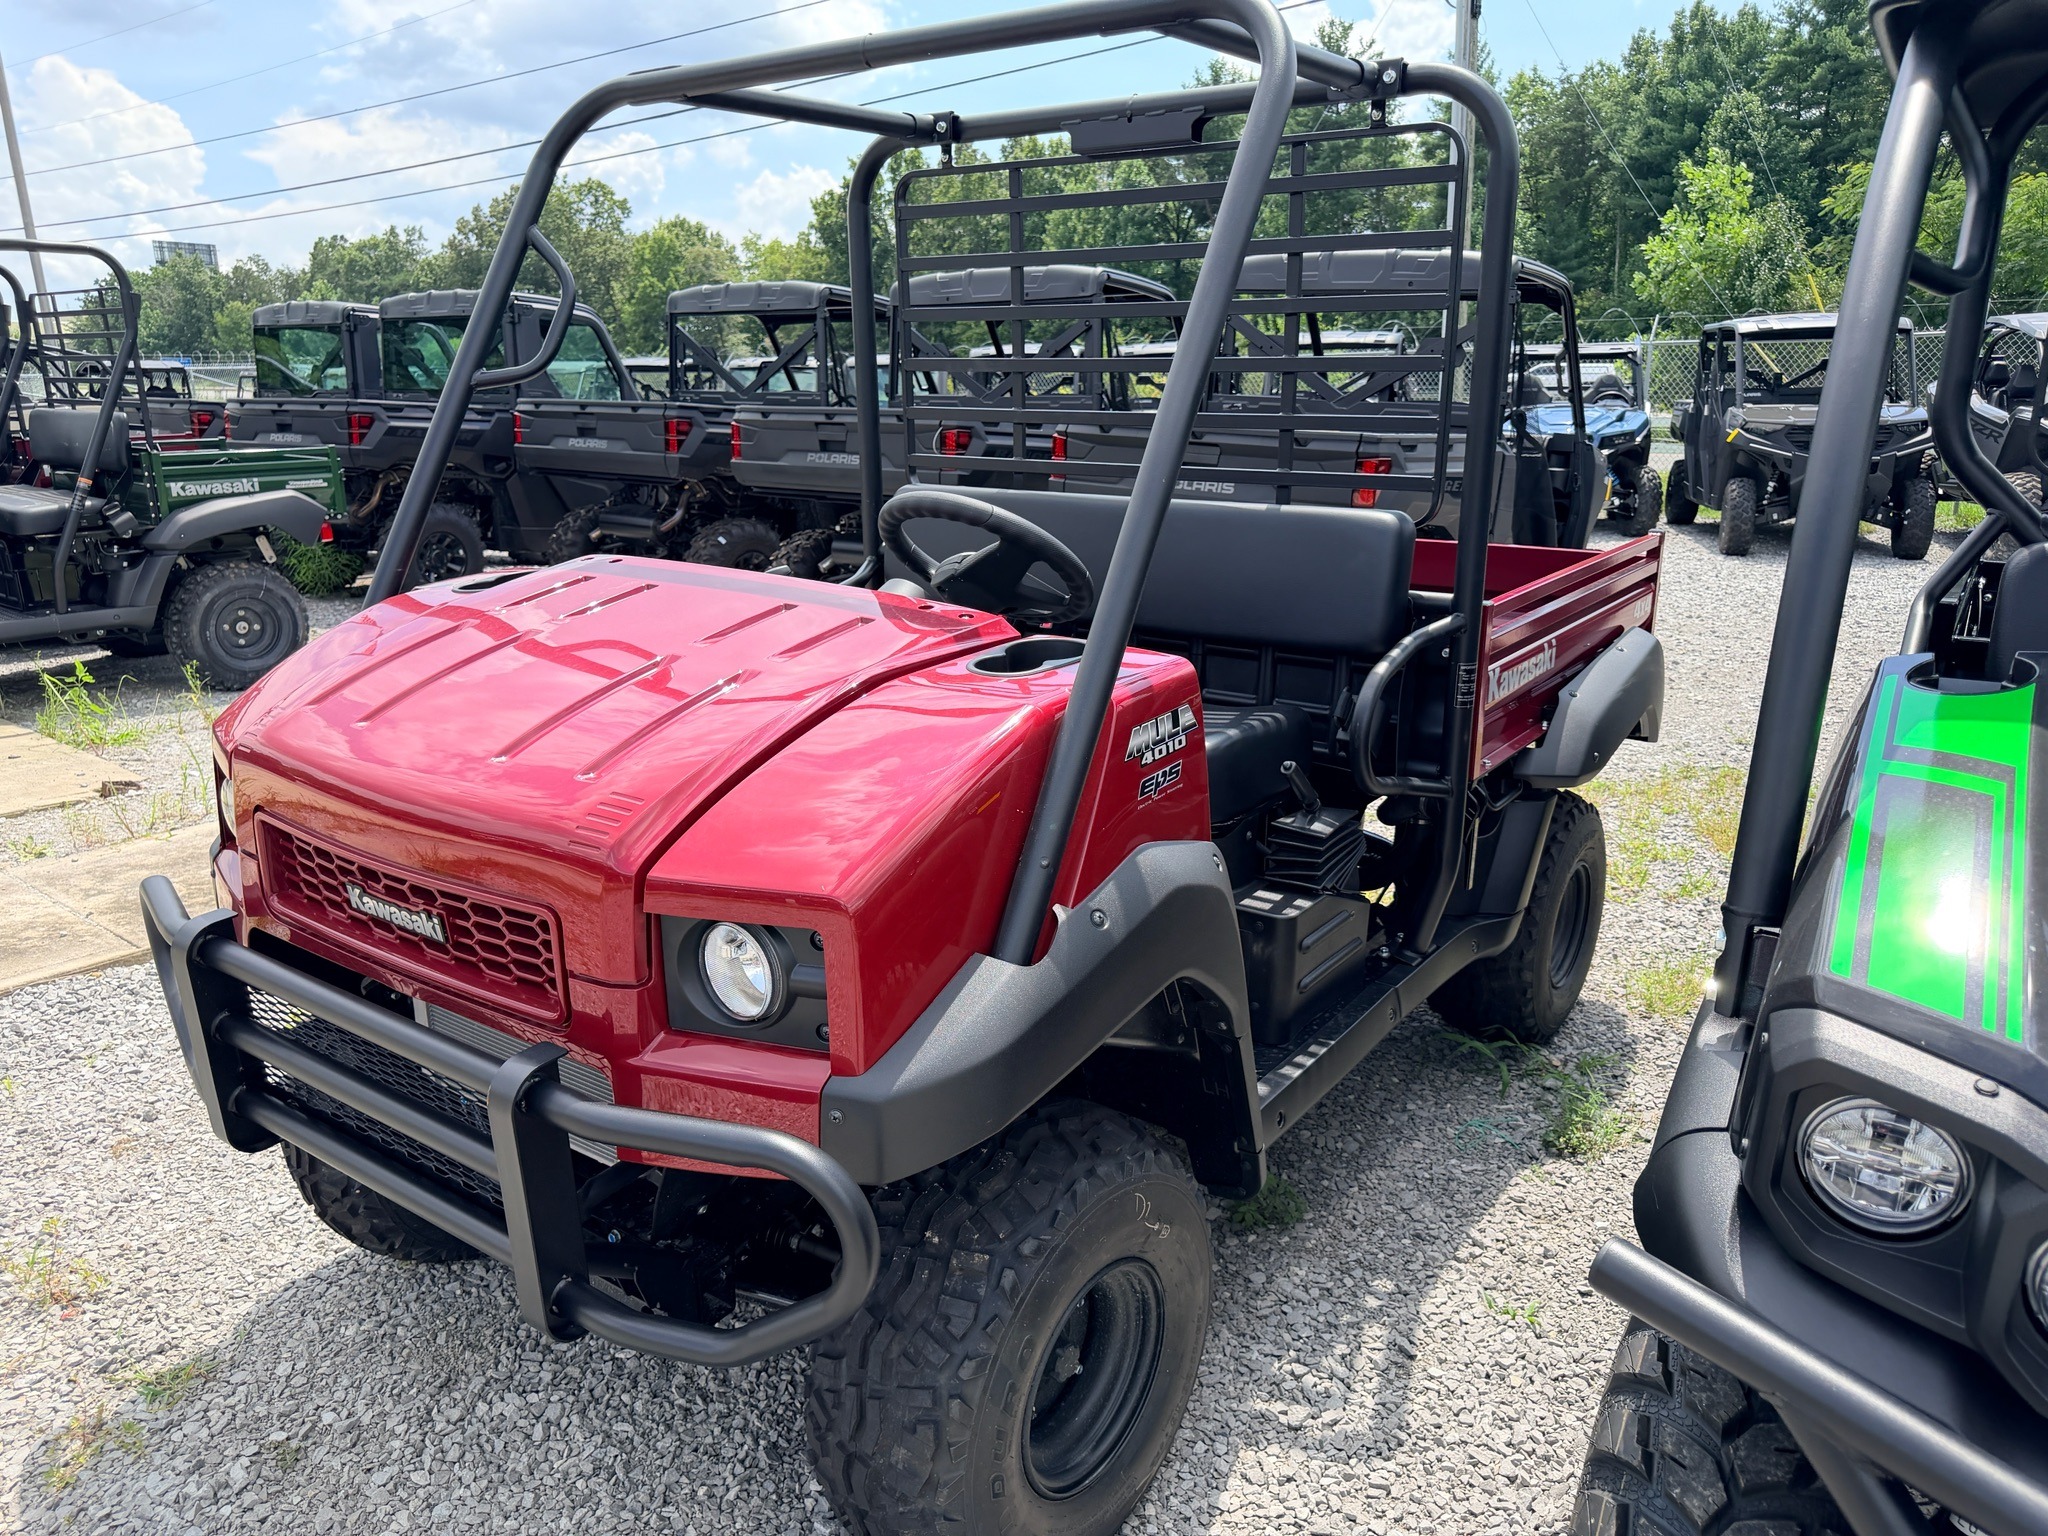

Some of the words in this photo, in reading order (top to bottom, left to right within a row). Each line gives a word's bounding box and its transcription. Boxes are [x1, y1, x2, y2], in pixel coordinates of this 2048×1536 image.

[269, 433, 303, 443] POLARIS
[568, 438, 608, 449] POLARIS
[806, 452, 861, 465] POLARIS
[168, 478, 260, 497] Kawasaki
[1174, 480, 1235, 494] OLARIS
[1488, 638, 1557, 702] Kawasaki
[1124, 703, 1199, 762] MULE
[1141, 734, 1188, 766] 4010
[1137, 759, 1183, 801] EPS
[345, 884, 444, 943] Kawasaki
